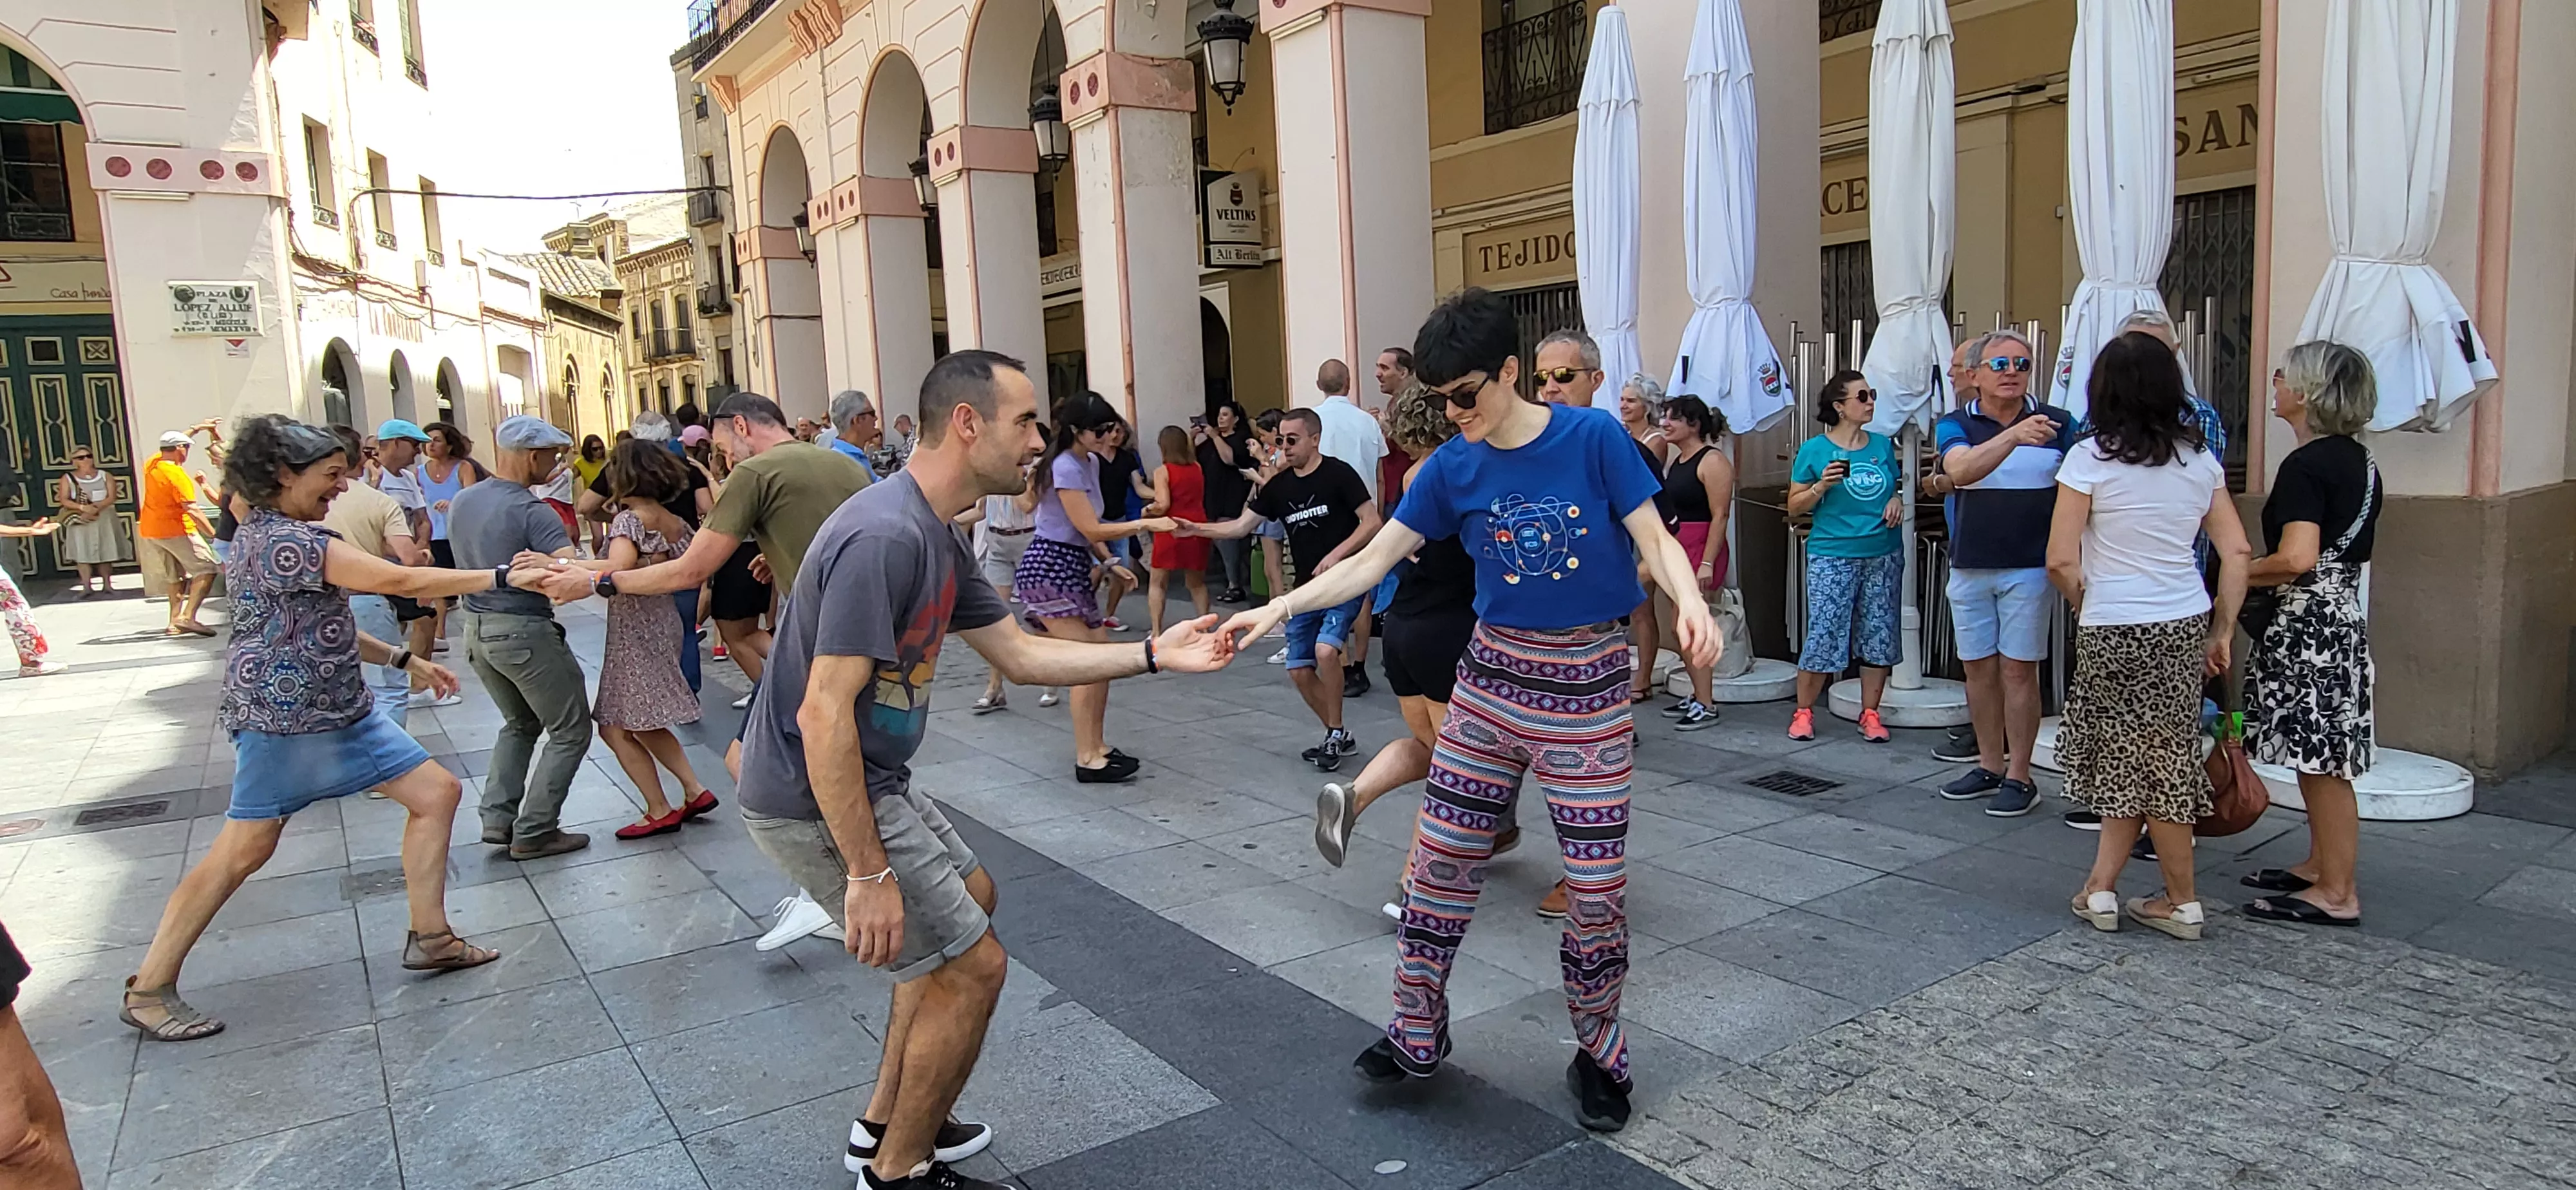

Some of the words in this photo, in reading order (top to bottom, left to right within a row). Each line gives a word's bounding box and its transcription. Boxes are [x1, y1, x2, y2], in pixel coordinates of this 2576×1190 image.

[1821, 176, 1868, 217] CE
[1216, 209, 1256, 221] VELTINS
[1216, 249, 1232, 260] Alt
[1235, 249, 1260, 260] Berlin
[1479, 231, 1575, 272] TEJIDO
[50, 288, 78, 298] Casa
[1847, 474, 1883, 486] SWING
